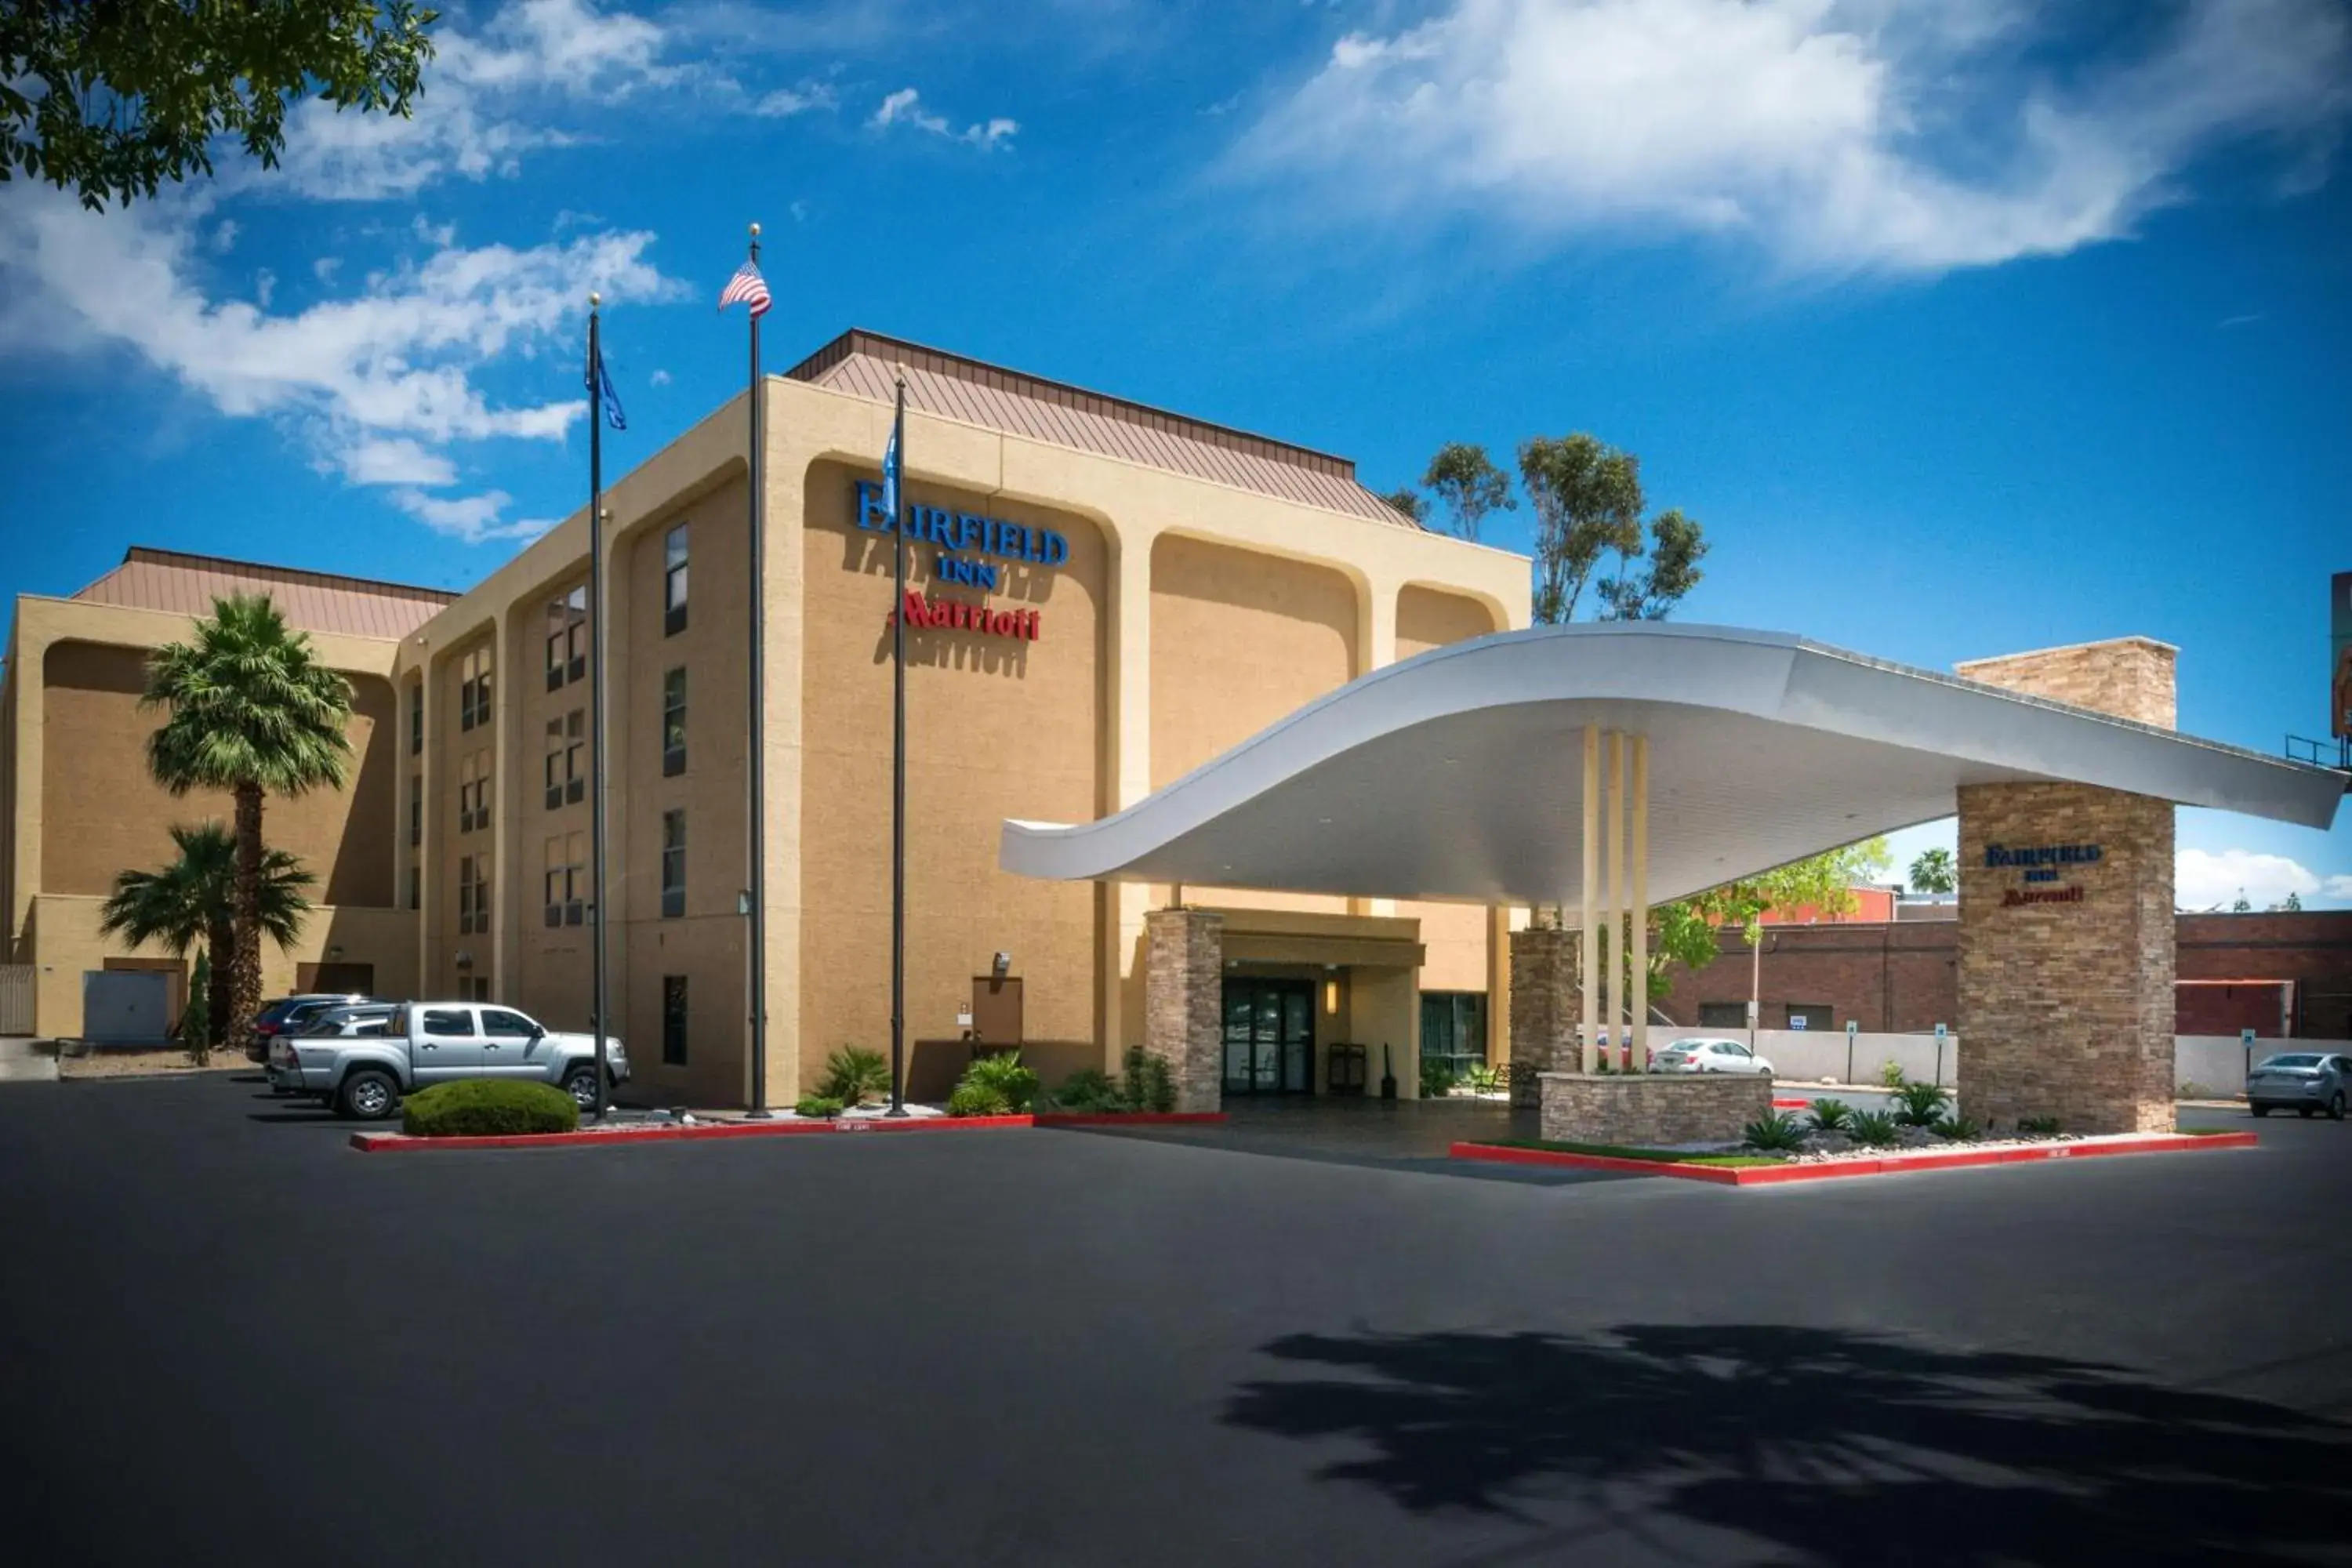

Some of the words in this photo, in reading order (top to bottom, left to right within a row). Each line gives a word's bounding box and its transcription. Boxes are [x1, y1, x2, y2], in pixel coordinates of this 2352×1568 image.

[938, 557, 996, 589] INN
[887, 590, 1040, 641] Marriott
[1986, 844, 2101, 866] FAIRFIELD
